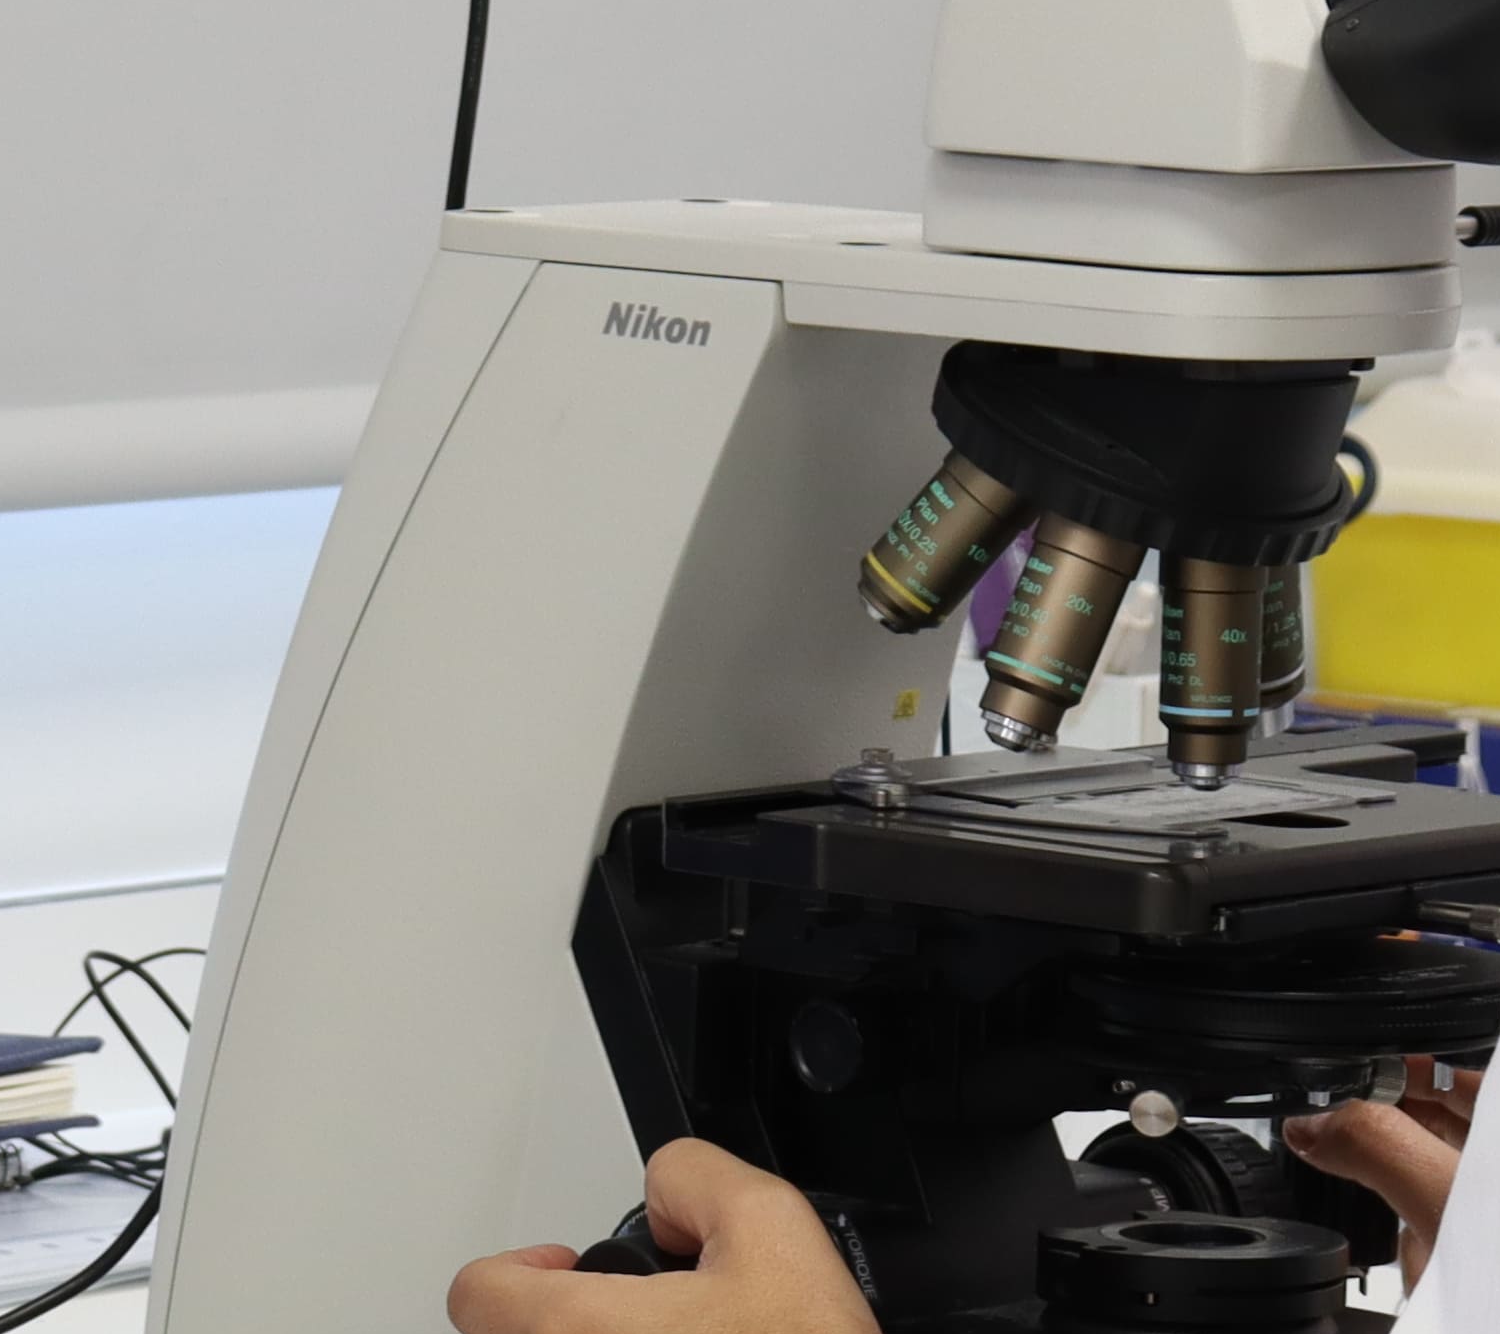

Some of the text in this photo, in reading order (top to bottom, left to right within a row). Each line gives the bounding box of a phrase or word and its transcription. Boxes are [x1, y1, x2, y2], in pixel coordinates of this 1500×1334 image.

[602, 301, 712, 347] Nikon
[1064, 594, 1095, 616] 20x
[1219, 628, 1248, 644] 40x
